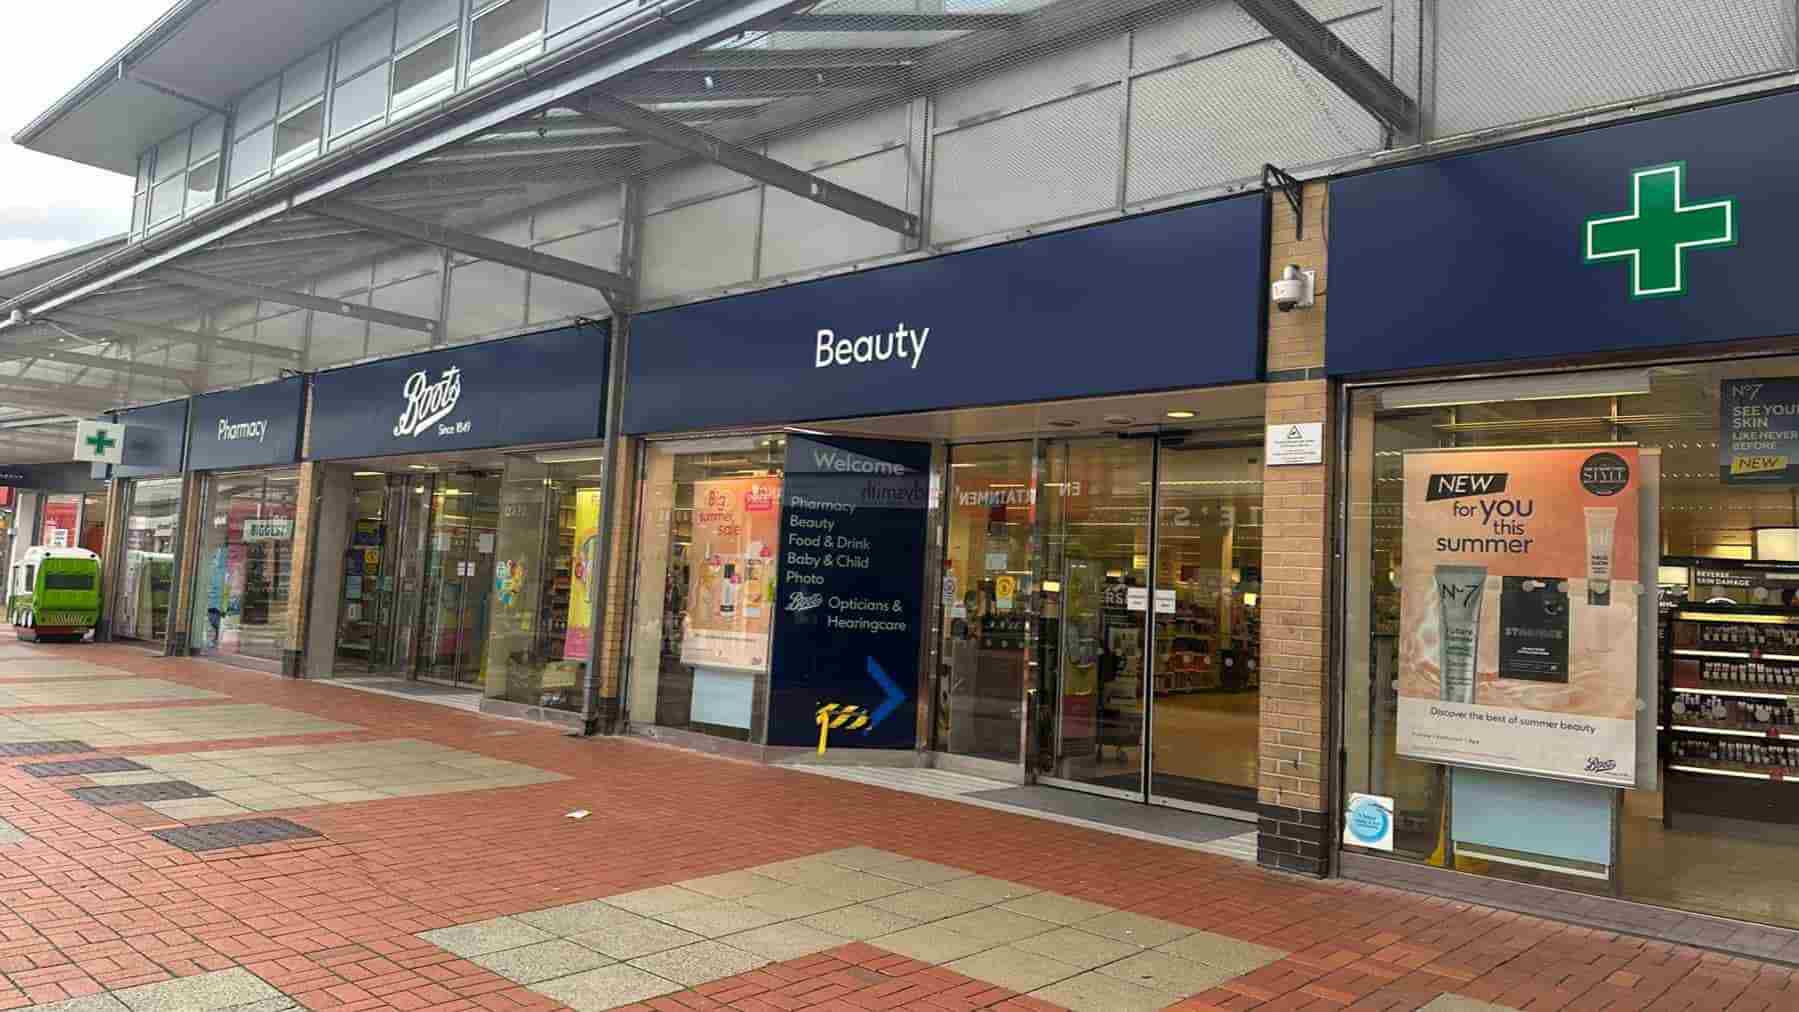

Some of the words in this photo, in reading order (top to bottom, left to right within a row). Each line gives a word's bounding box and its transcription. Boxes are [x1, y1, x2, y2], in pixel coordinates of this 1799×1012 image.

[816, 323, 930, 369] Beauty
[393, 366, 460, 437] Boots
[1734, 406, 1760, 416] SEE
[217, 418, 268, 443] Pharmacy
[1734, 416, 1768, 428] SKIN
[814, 450, 905, 475] Welcome
[1736, 457, 1778, 469] NEW
[1437, 475, 1495, 494] NEW
[791, 496, 856, 515] Pharmacy
[1453, 501, 1477, 517] for
[1479, 499, 1533, 525] you
[790, 515, 835, 531] Beauty
[1493, 520, 1525, 536] this
[789, 533, 821, 546] Food
[824, 535, 834, 547] &
[837, 536, 871, 550] Drink
[1436, 536, 1534, 553] summer
[787, 552, 820, 568] Baby
[823, 553, 834, 567] &
[836, 554, 870, 569] Child
[786, 570, 825, 585] Photo
[1716, 578, 1751, 586] DAMAGE
[828, 596, 889, 612] Opticians
[892, 599, 903, 612] &
[827, 615, 907, 633] Hearingcare
[1430, 706, 1467, 718] Discover
[1470, 710, 1483, 721] the
[1486, 712, 1506, 723] best
[1508, 715, 1518, 725] of
[1520, 719, 1558, 729] summer
[1560, 719, 1596, 734] beauty
